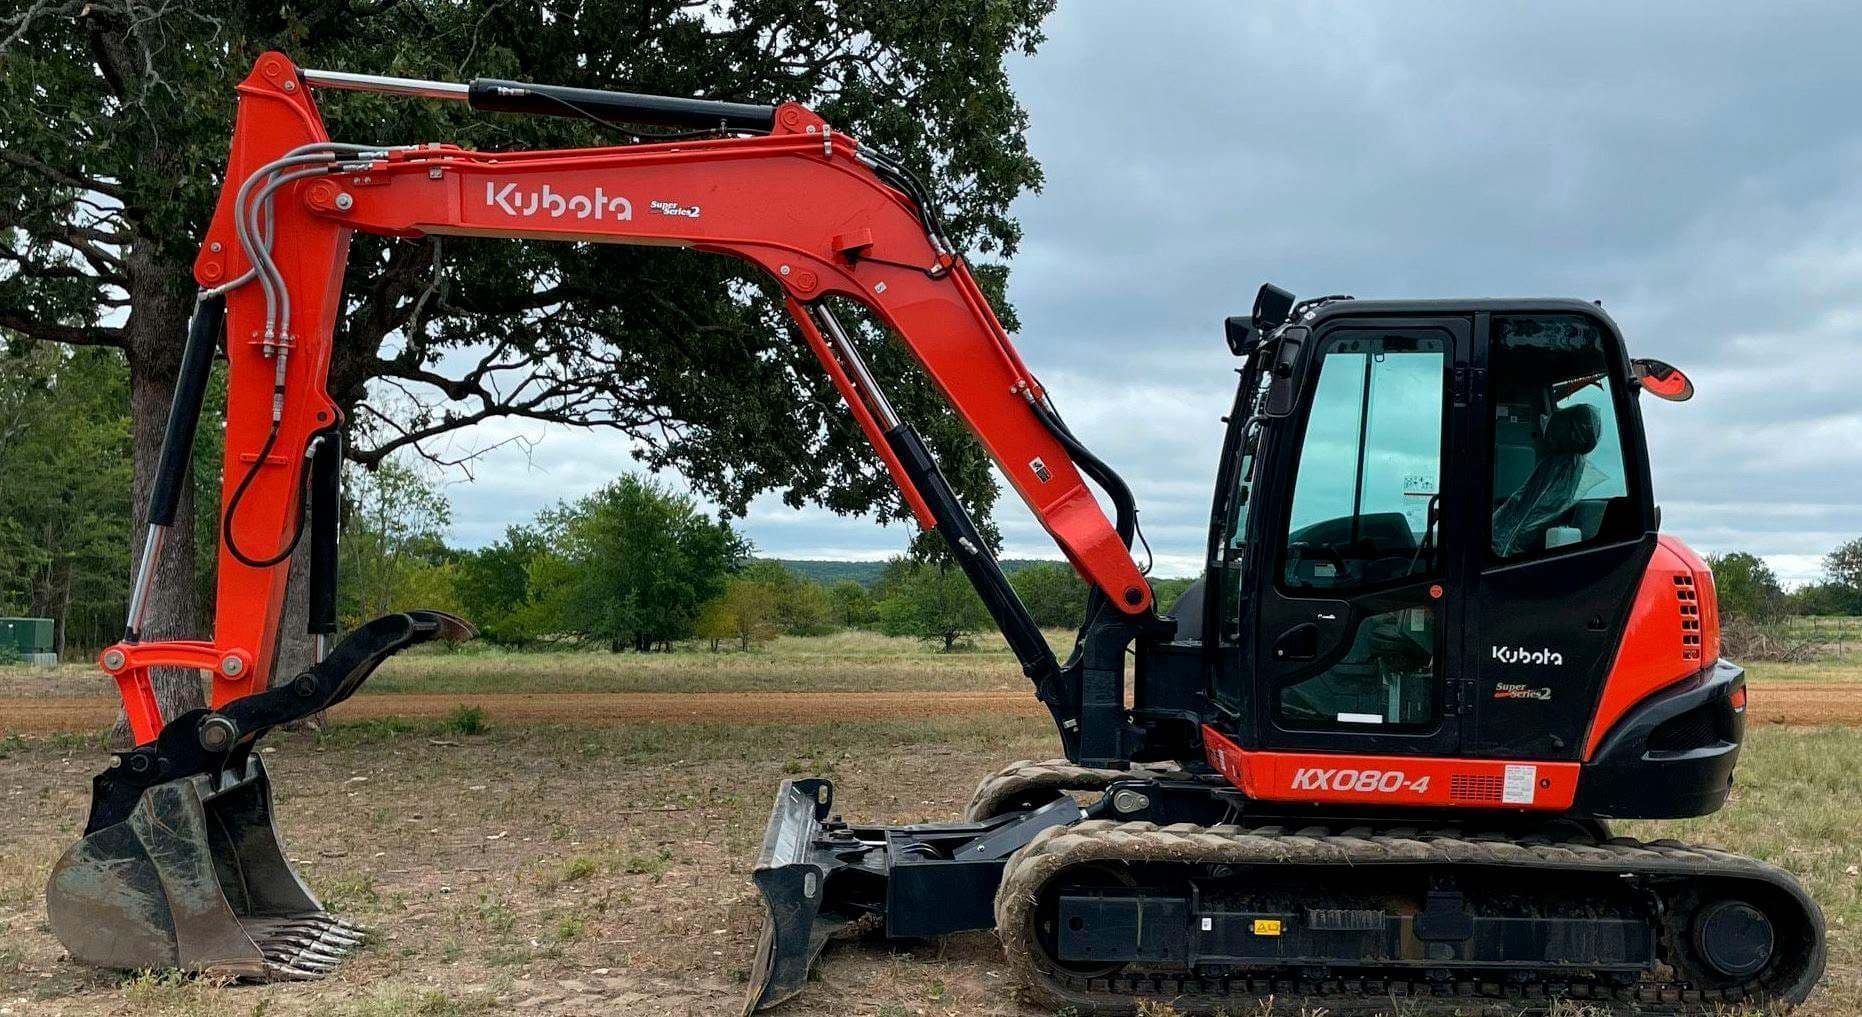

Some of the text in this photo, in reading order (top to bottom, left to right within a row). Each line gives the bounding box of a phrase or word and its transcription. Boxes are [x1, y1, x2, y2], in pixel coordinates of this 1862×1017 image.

[486, 181, 632, 221] Kubota
[650, 200, 678, 210] Super
[1492, 645, 1563, 666] Kubota
[1495, 682, 1527, 692] Super
[1290, 768, 1431, 794] KX080-4
